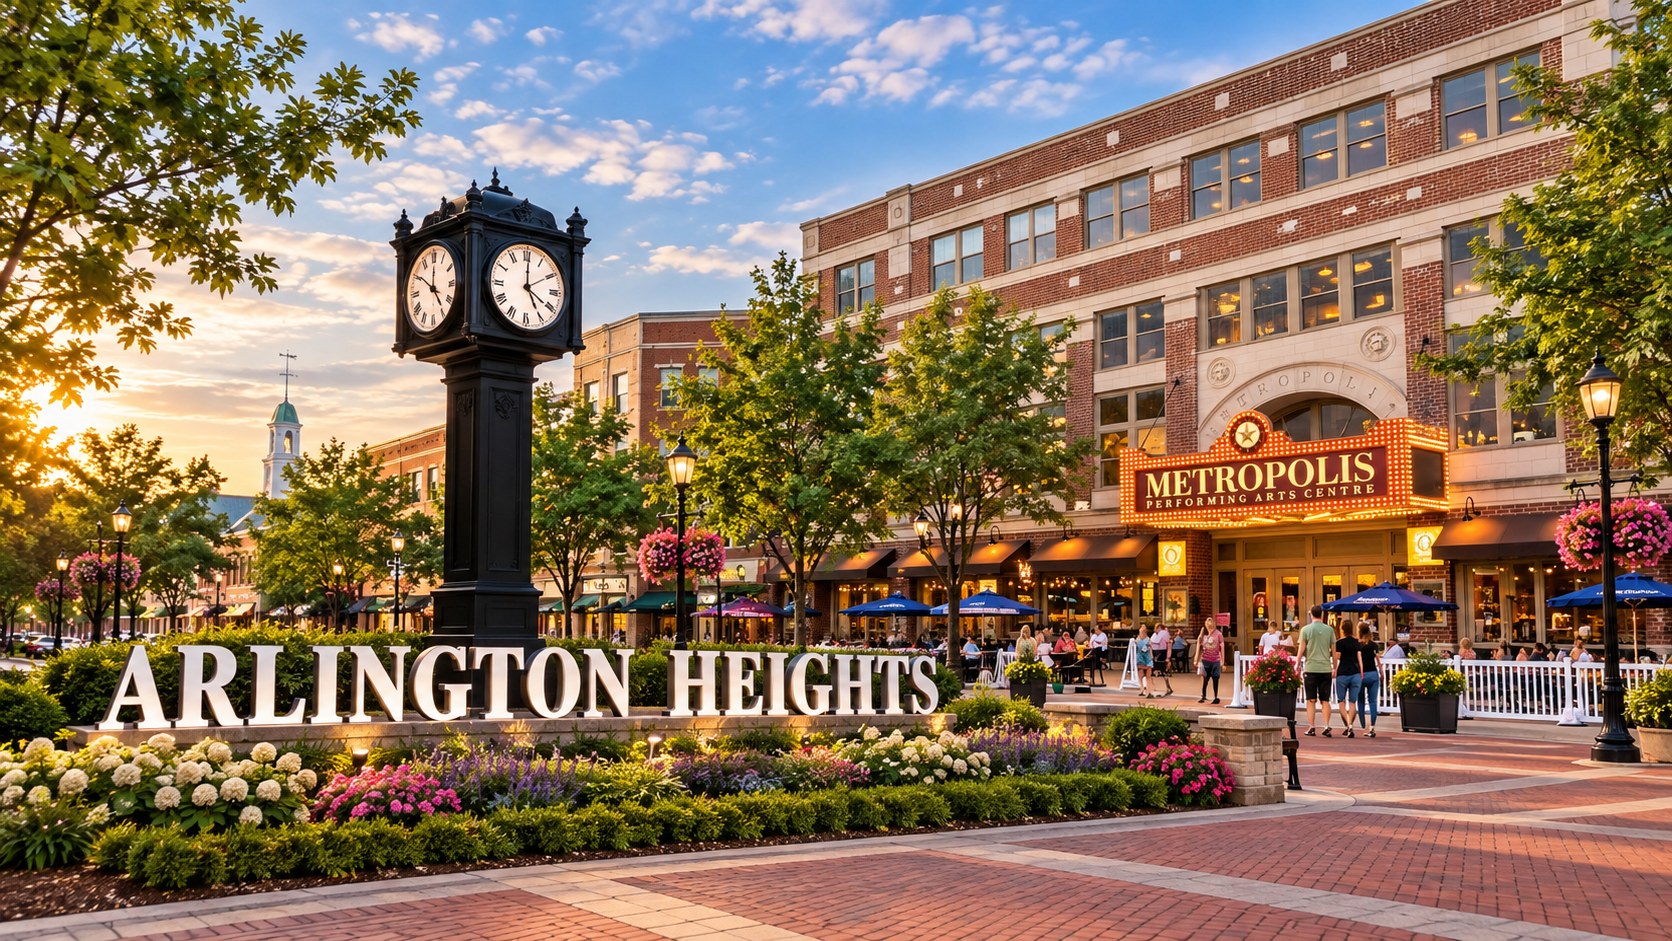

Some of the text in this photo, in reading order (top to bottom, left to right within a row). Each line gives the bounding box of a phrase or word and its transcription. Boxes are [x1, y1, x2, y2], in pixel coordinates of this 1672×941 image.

[1145, 452, 1375, 498] METROPOLIS
[1146, 484, 1375, 509] PERFORMING ARTS CENTRE
[96, 644, 939, 730] ARLINGTON HEIGHTS
